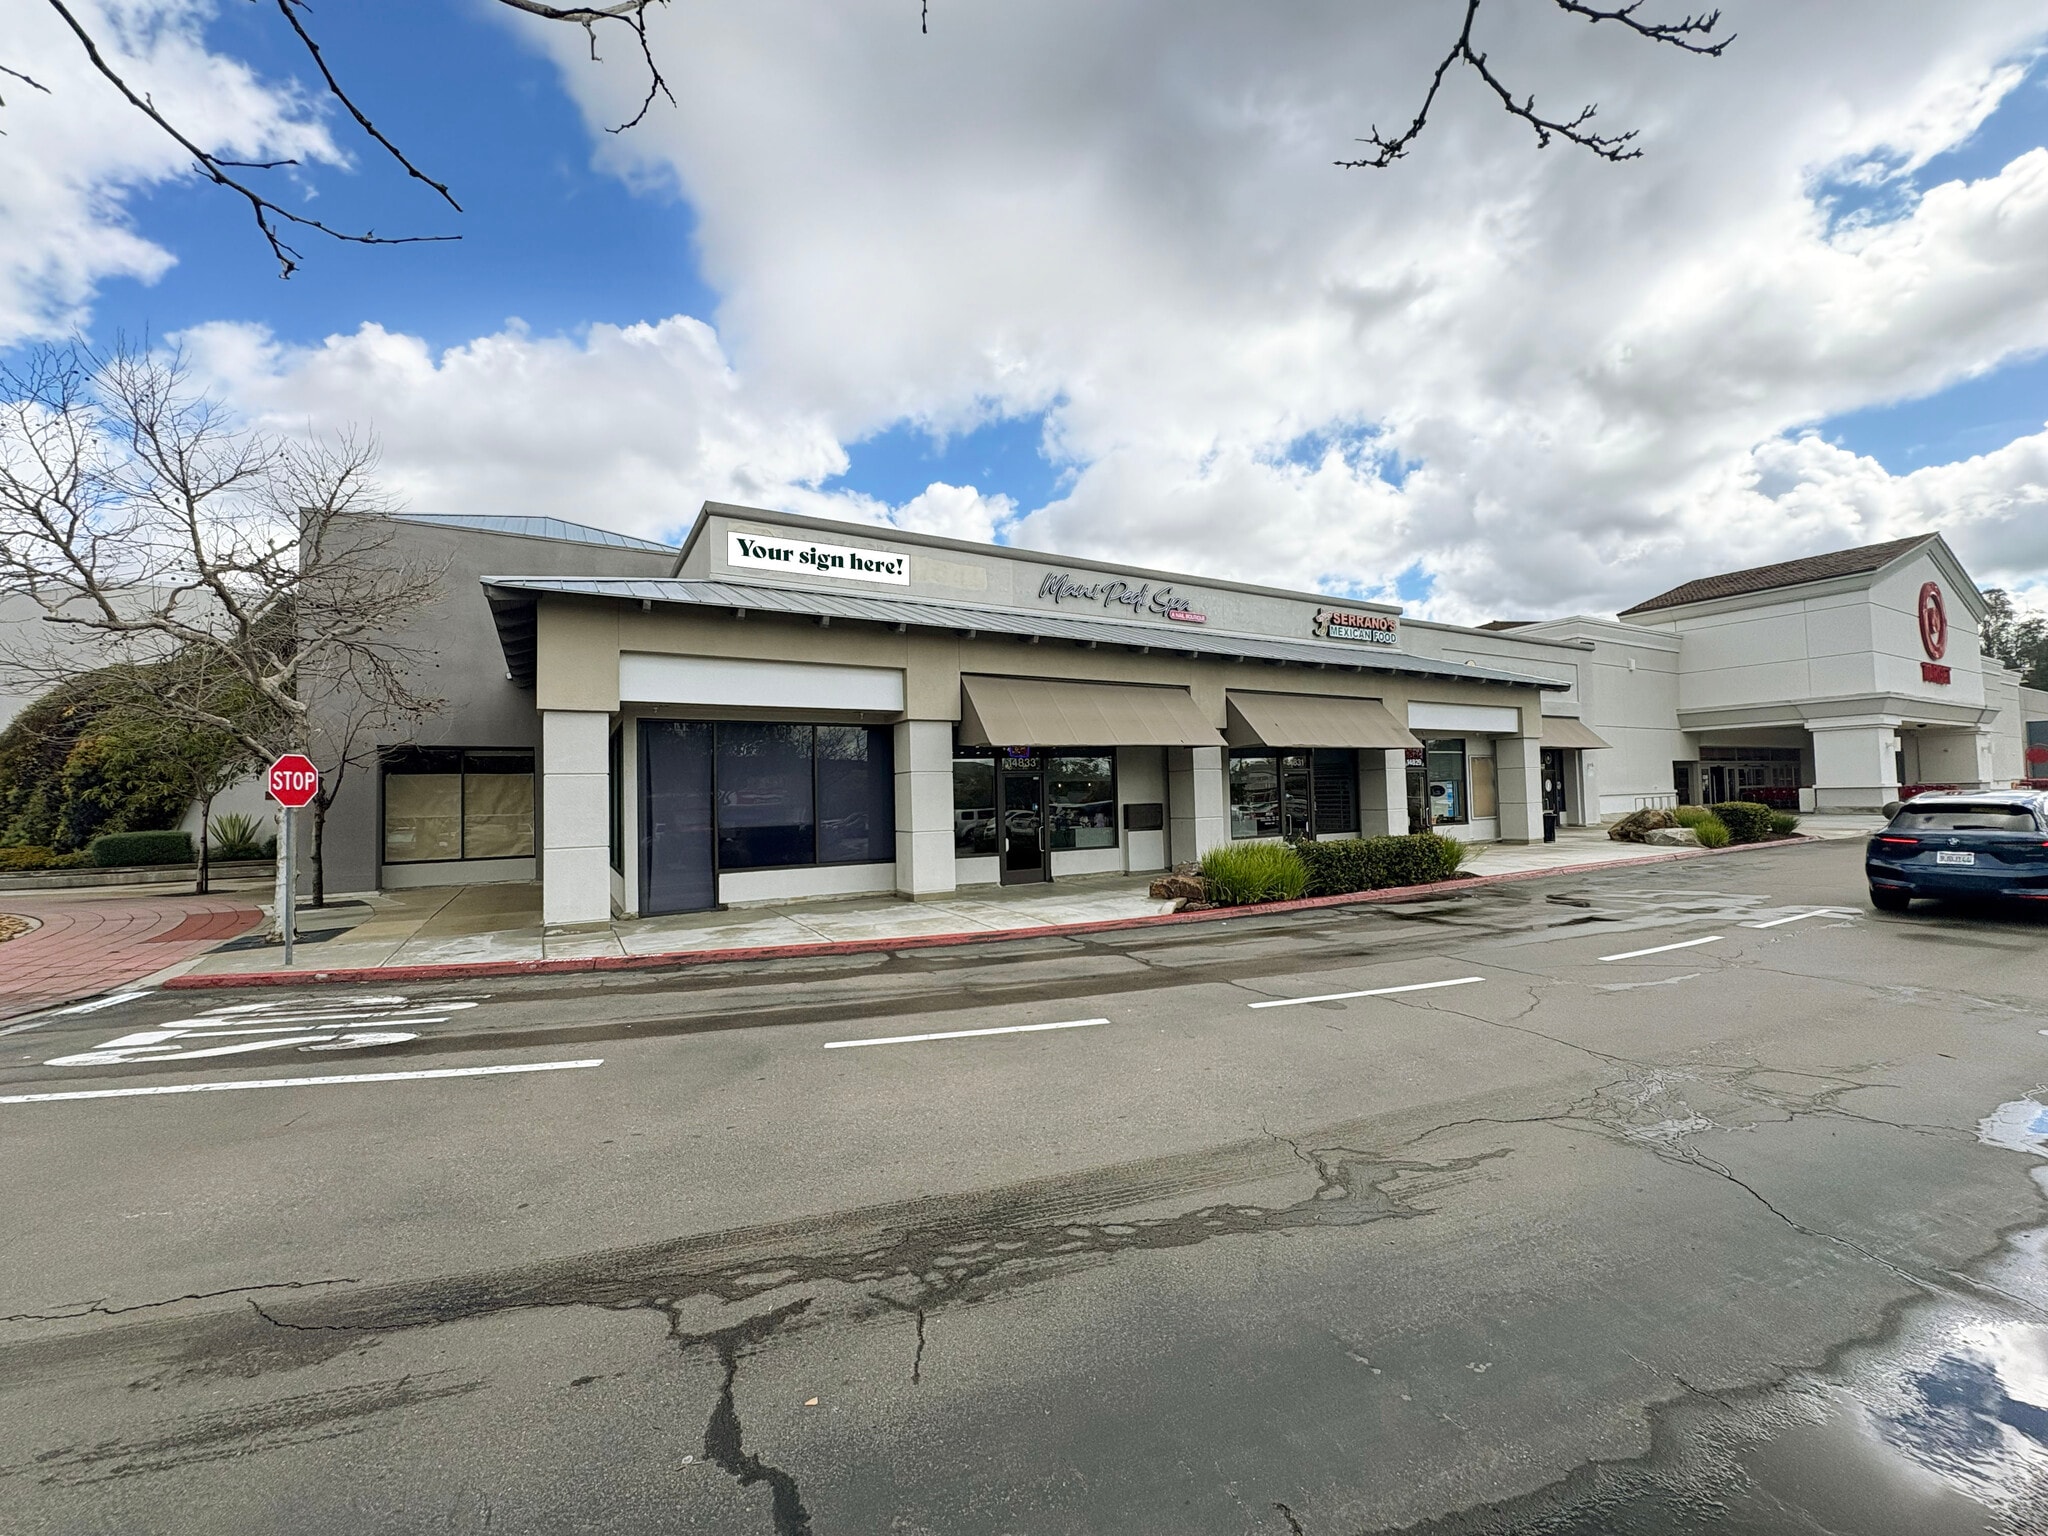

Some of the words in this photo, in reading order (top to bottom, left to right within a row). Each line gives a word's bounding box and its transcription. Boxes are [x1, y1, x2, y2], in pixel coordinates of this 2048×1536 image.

[736, 537, 794, 563] Your
[799, 547, 845, 572] sign
[849, 553, 904, 576] here!
[1039, 572, 1101, 605] Mani
[1101, 580, 1150, 614] Pedi
[1149, 585, 1194, 618] Spa
[1333, 612, 1397, 632] SERRANO'S
[1330, 625, 1372, 641] MEXICAN
[1373, 630, 1397, 643] FOOD
[272, 770, 316, 791] STOP
